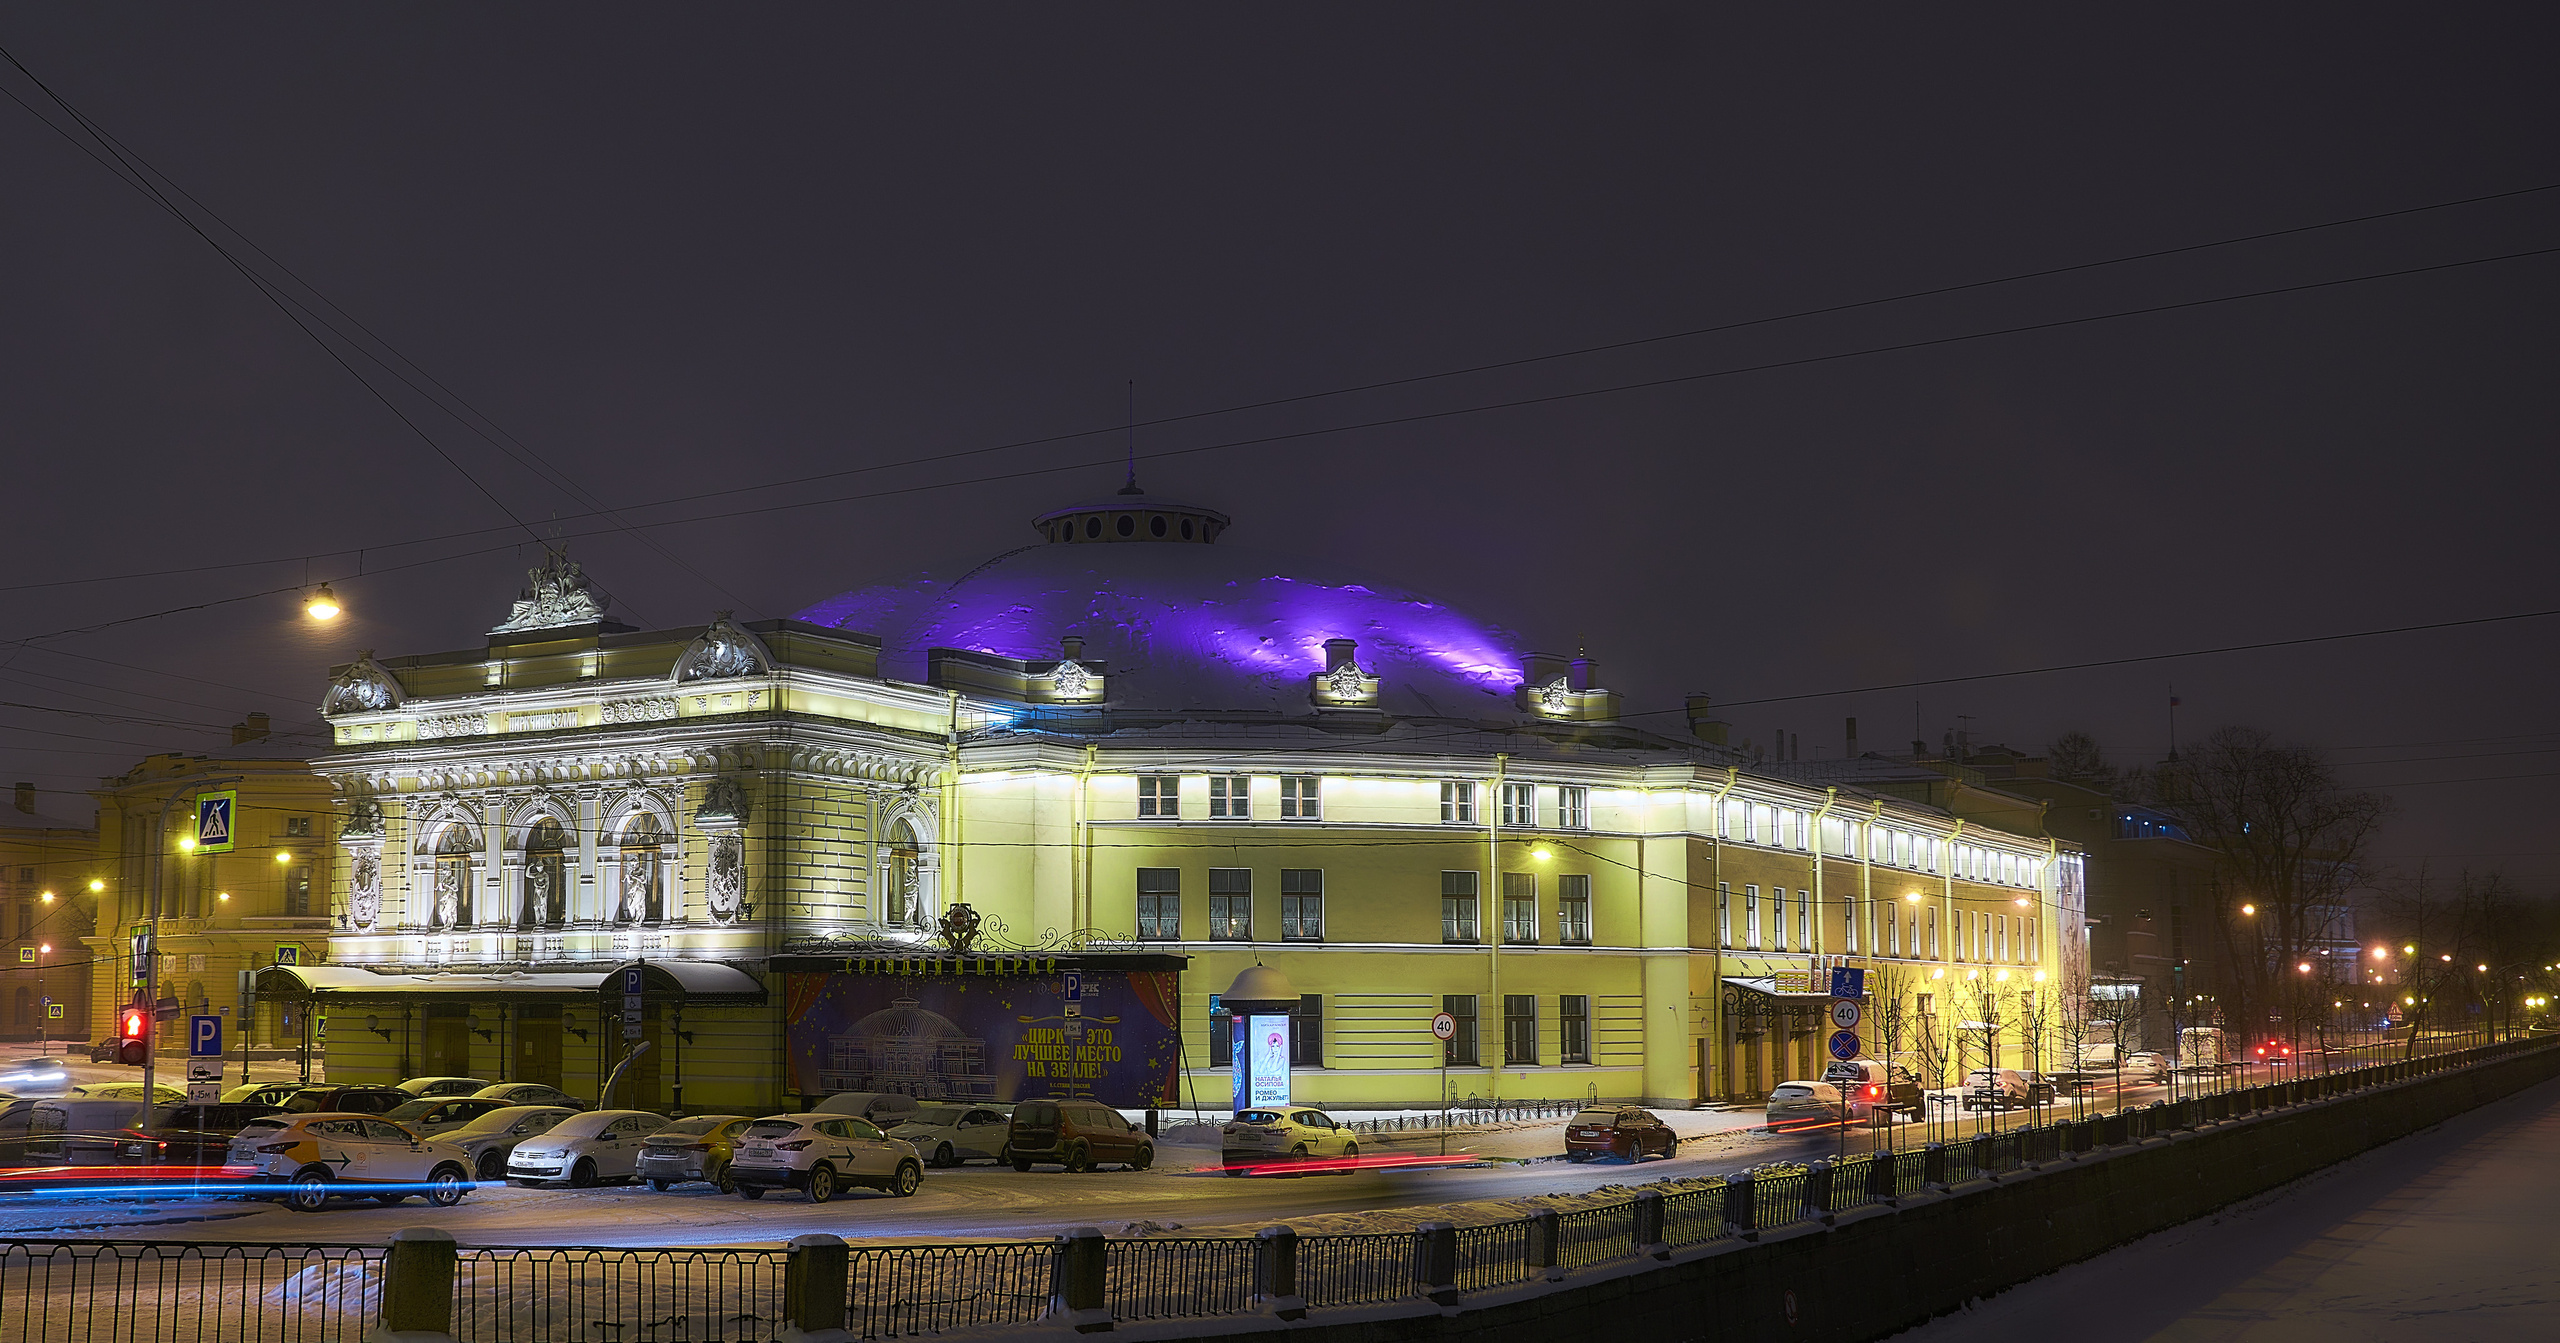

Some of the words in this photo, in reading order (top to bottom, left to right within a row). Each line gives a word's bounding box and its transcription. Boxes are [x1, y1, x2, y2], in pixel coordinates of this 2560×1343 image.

[509, 716, 530, 732] ЦИРК
[530, 711, 578, 731] ЧИНИЗЕЛЛИ
[1837, 1008, 1854, 1020] 40
[1437, 1020, 1451, 1031] 40
[1021, 1028, 1065, 1045] «ЦИРК
[1086, 1028, 1113, 1045] ЭТО
[1012, 1044, 1071, 1061] ЛУЧШЕЕ
[1075, 1045, 1122, 1062] МЕСТО
[1027, 1062, 1046, 1077] НА
[1050, 1062, 1108, 1079] ЗЕМЛЕ!»
